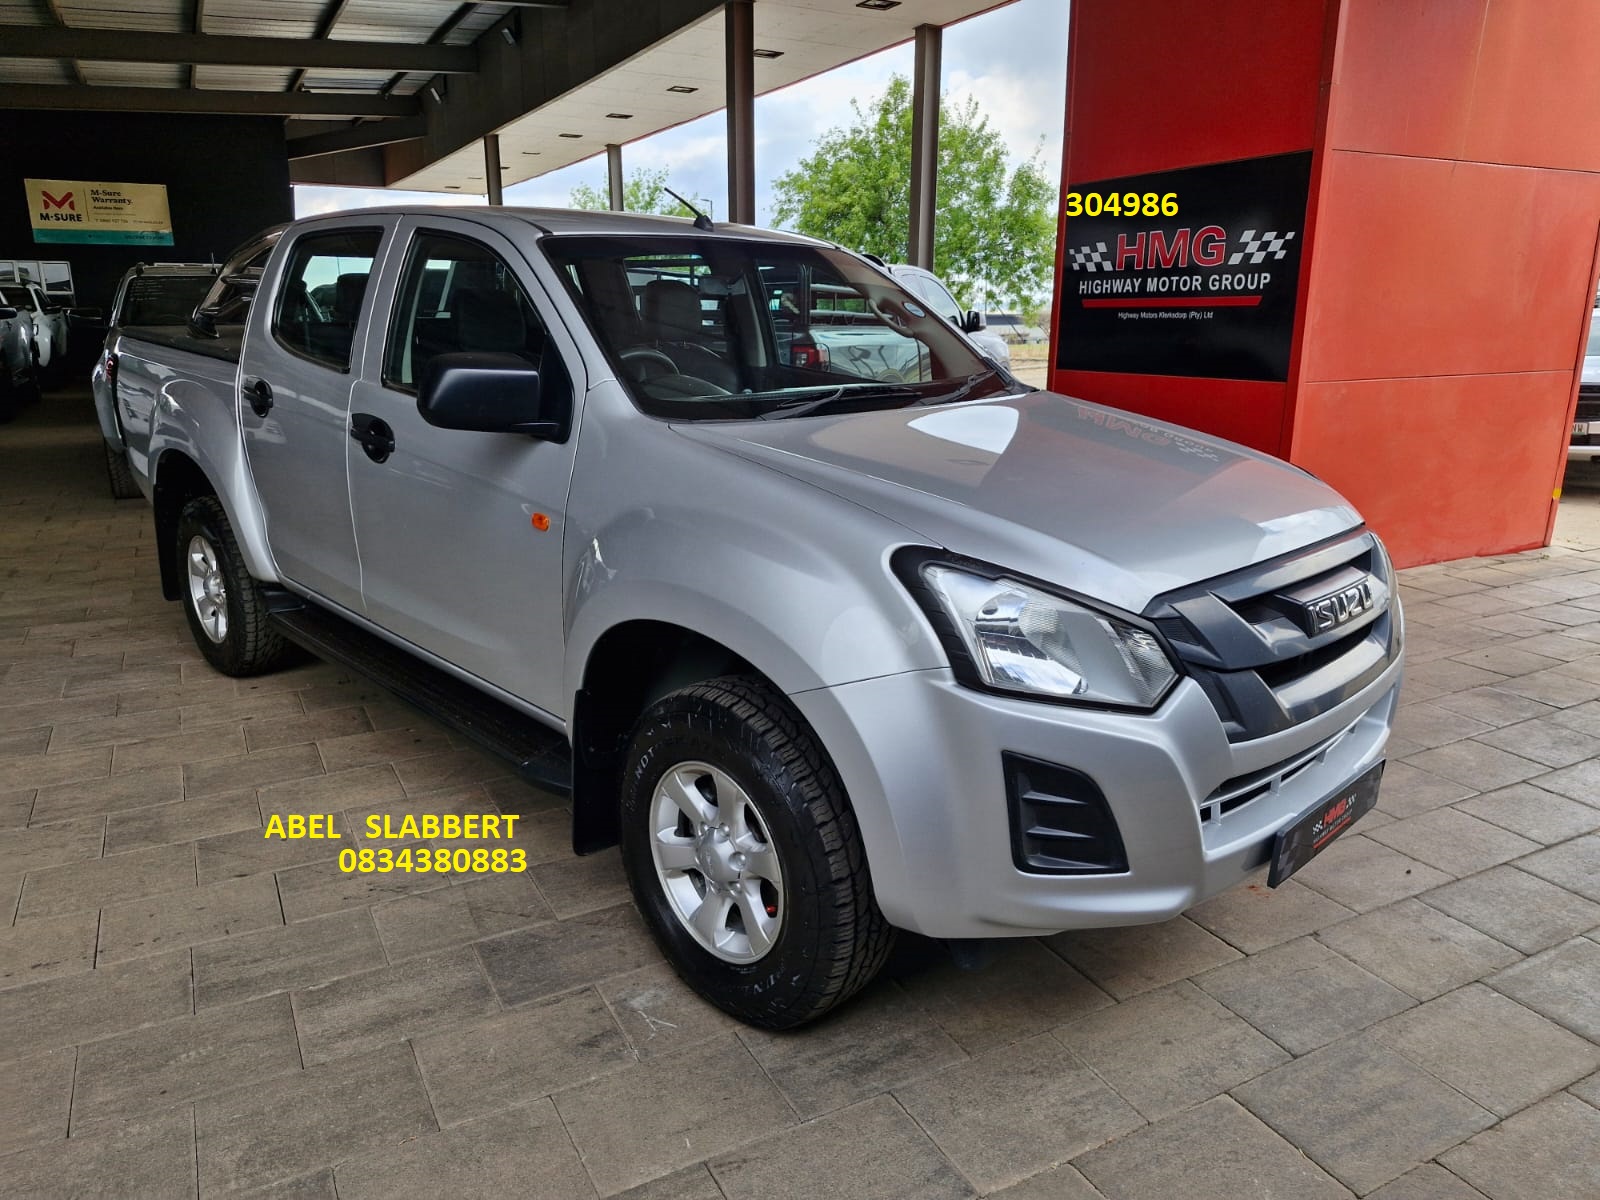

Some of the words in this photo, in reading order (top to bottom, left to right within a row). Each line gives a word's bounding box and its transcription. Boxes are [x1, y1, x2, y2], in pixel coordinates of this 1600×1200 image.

[90, 189, 121, 197] M-Sure
[1116, 225, 1227, 271] HMG
[1079, 277, 1142, 294] HIGHWAY
[1146, 275, 1203, 292] MOTOR
[1208, 272, 1272, 290] GROUP
[1118, 311, 1139, 320] Highway
[1140, 311, 1158, 319] Motors
[1188, 311, 1203, 320] (Pty)
[1203, 311, 1214, 319] Ltd
[1308, 581, 1374, 634] ISUZU
